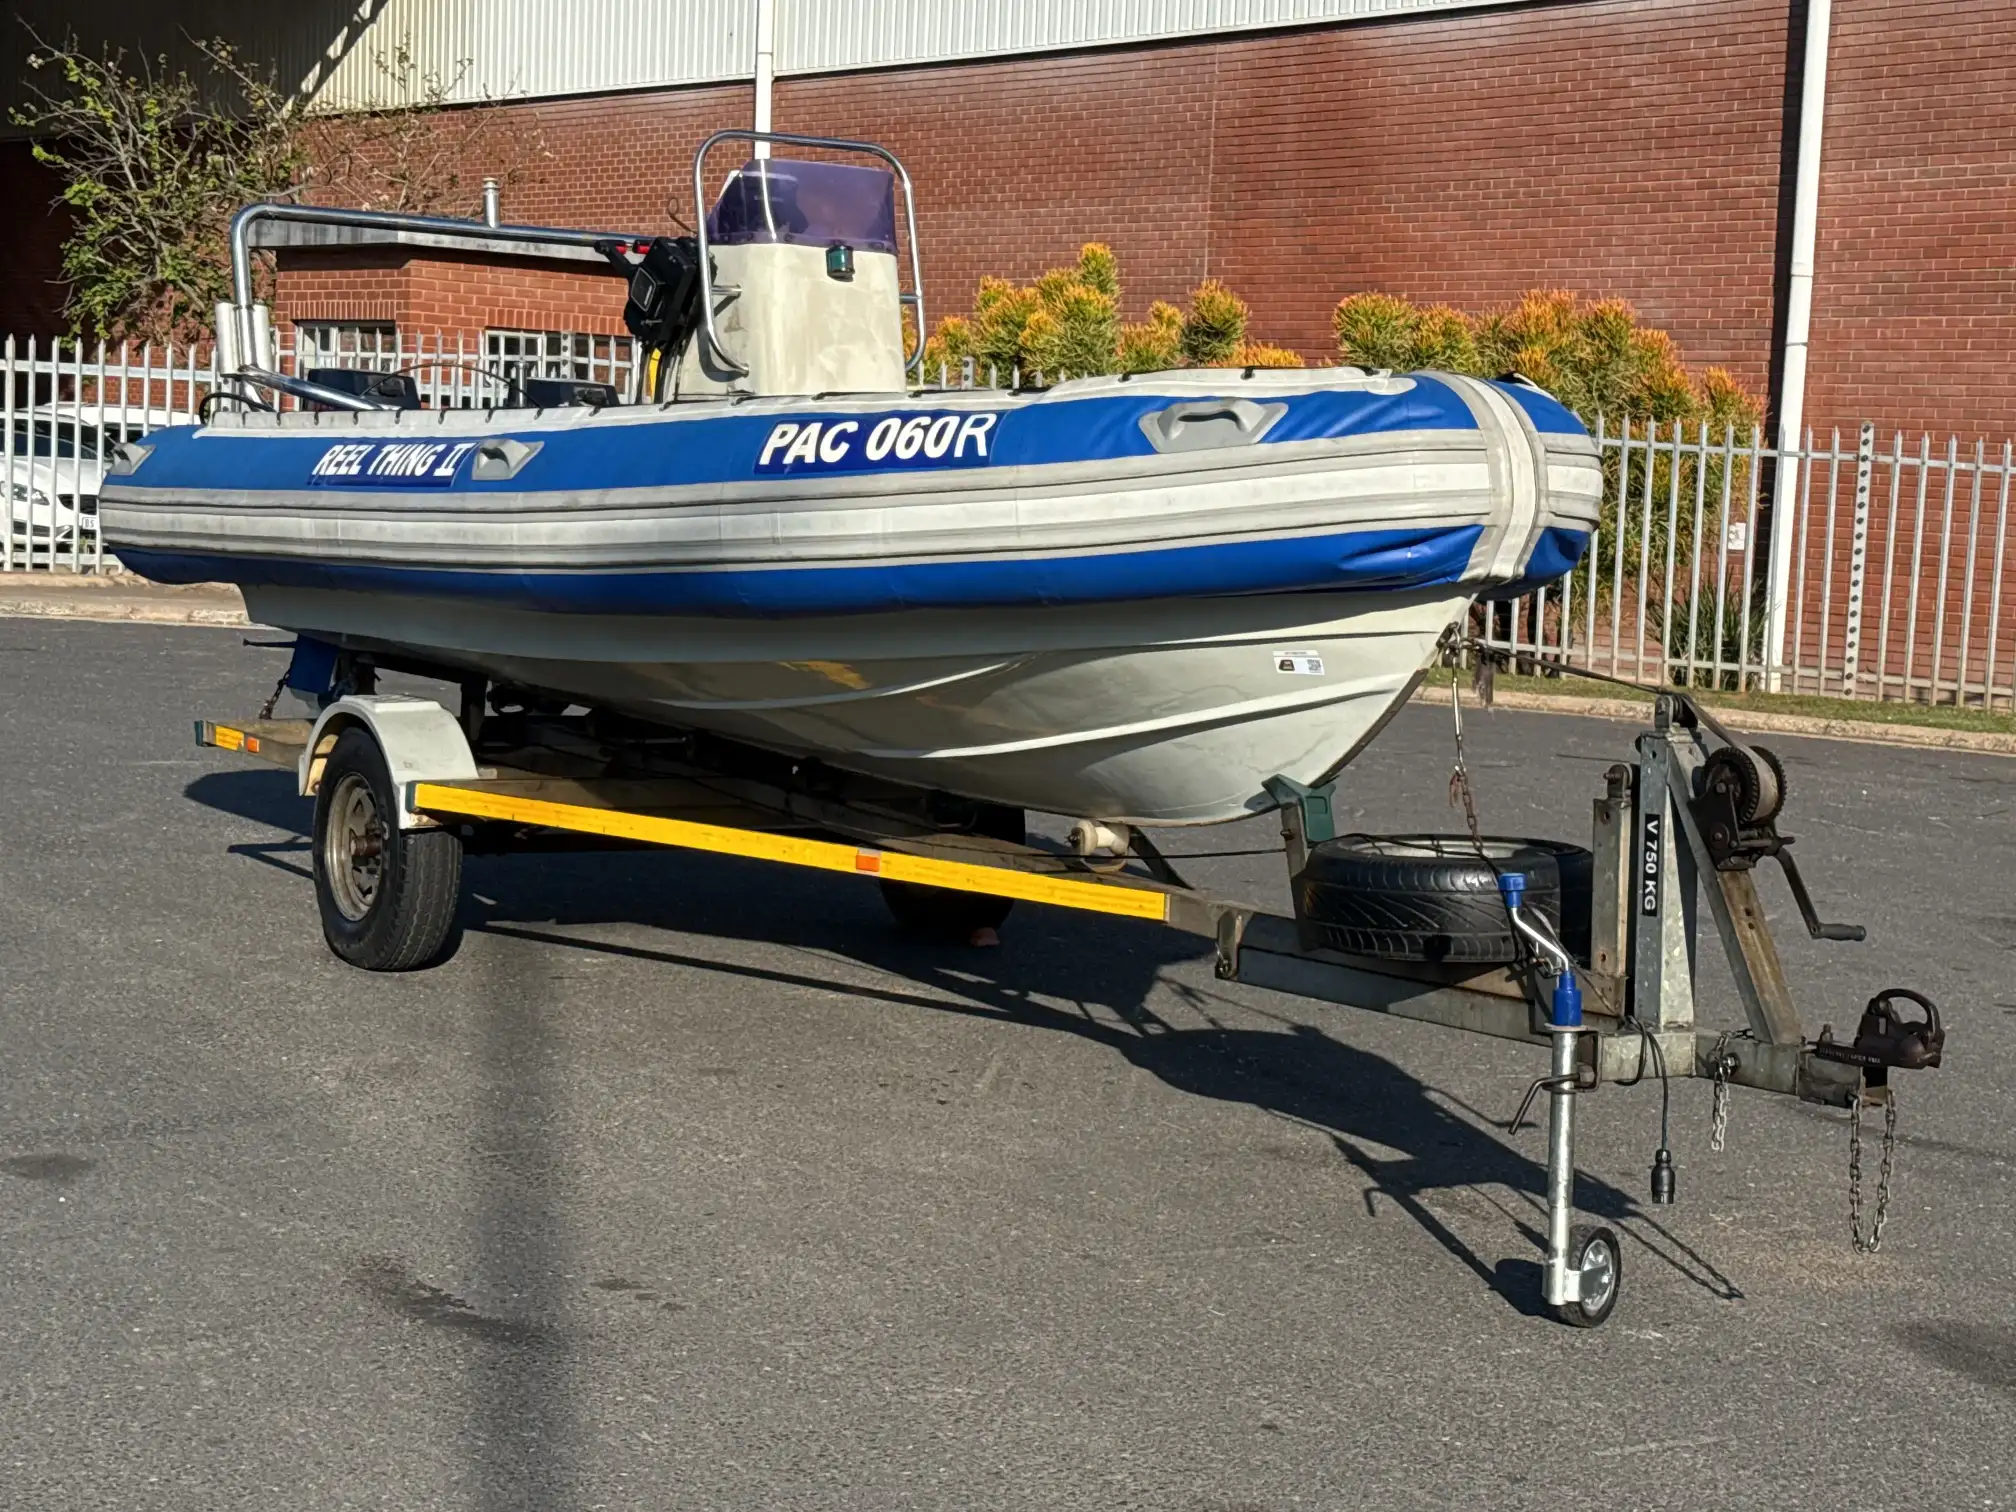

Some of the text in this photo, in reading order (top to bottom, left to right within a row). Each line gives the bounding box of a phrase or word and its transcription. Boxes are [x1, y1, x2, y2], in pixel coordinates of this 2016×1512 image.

[312, 442, 477, 477] REEL THING II
[759, 413, 998, 465] PAC 060R
[1644, 820, 1659, 911] V 750 KG
